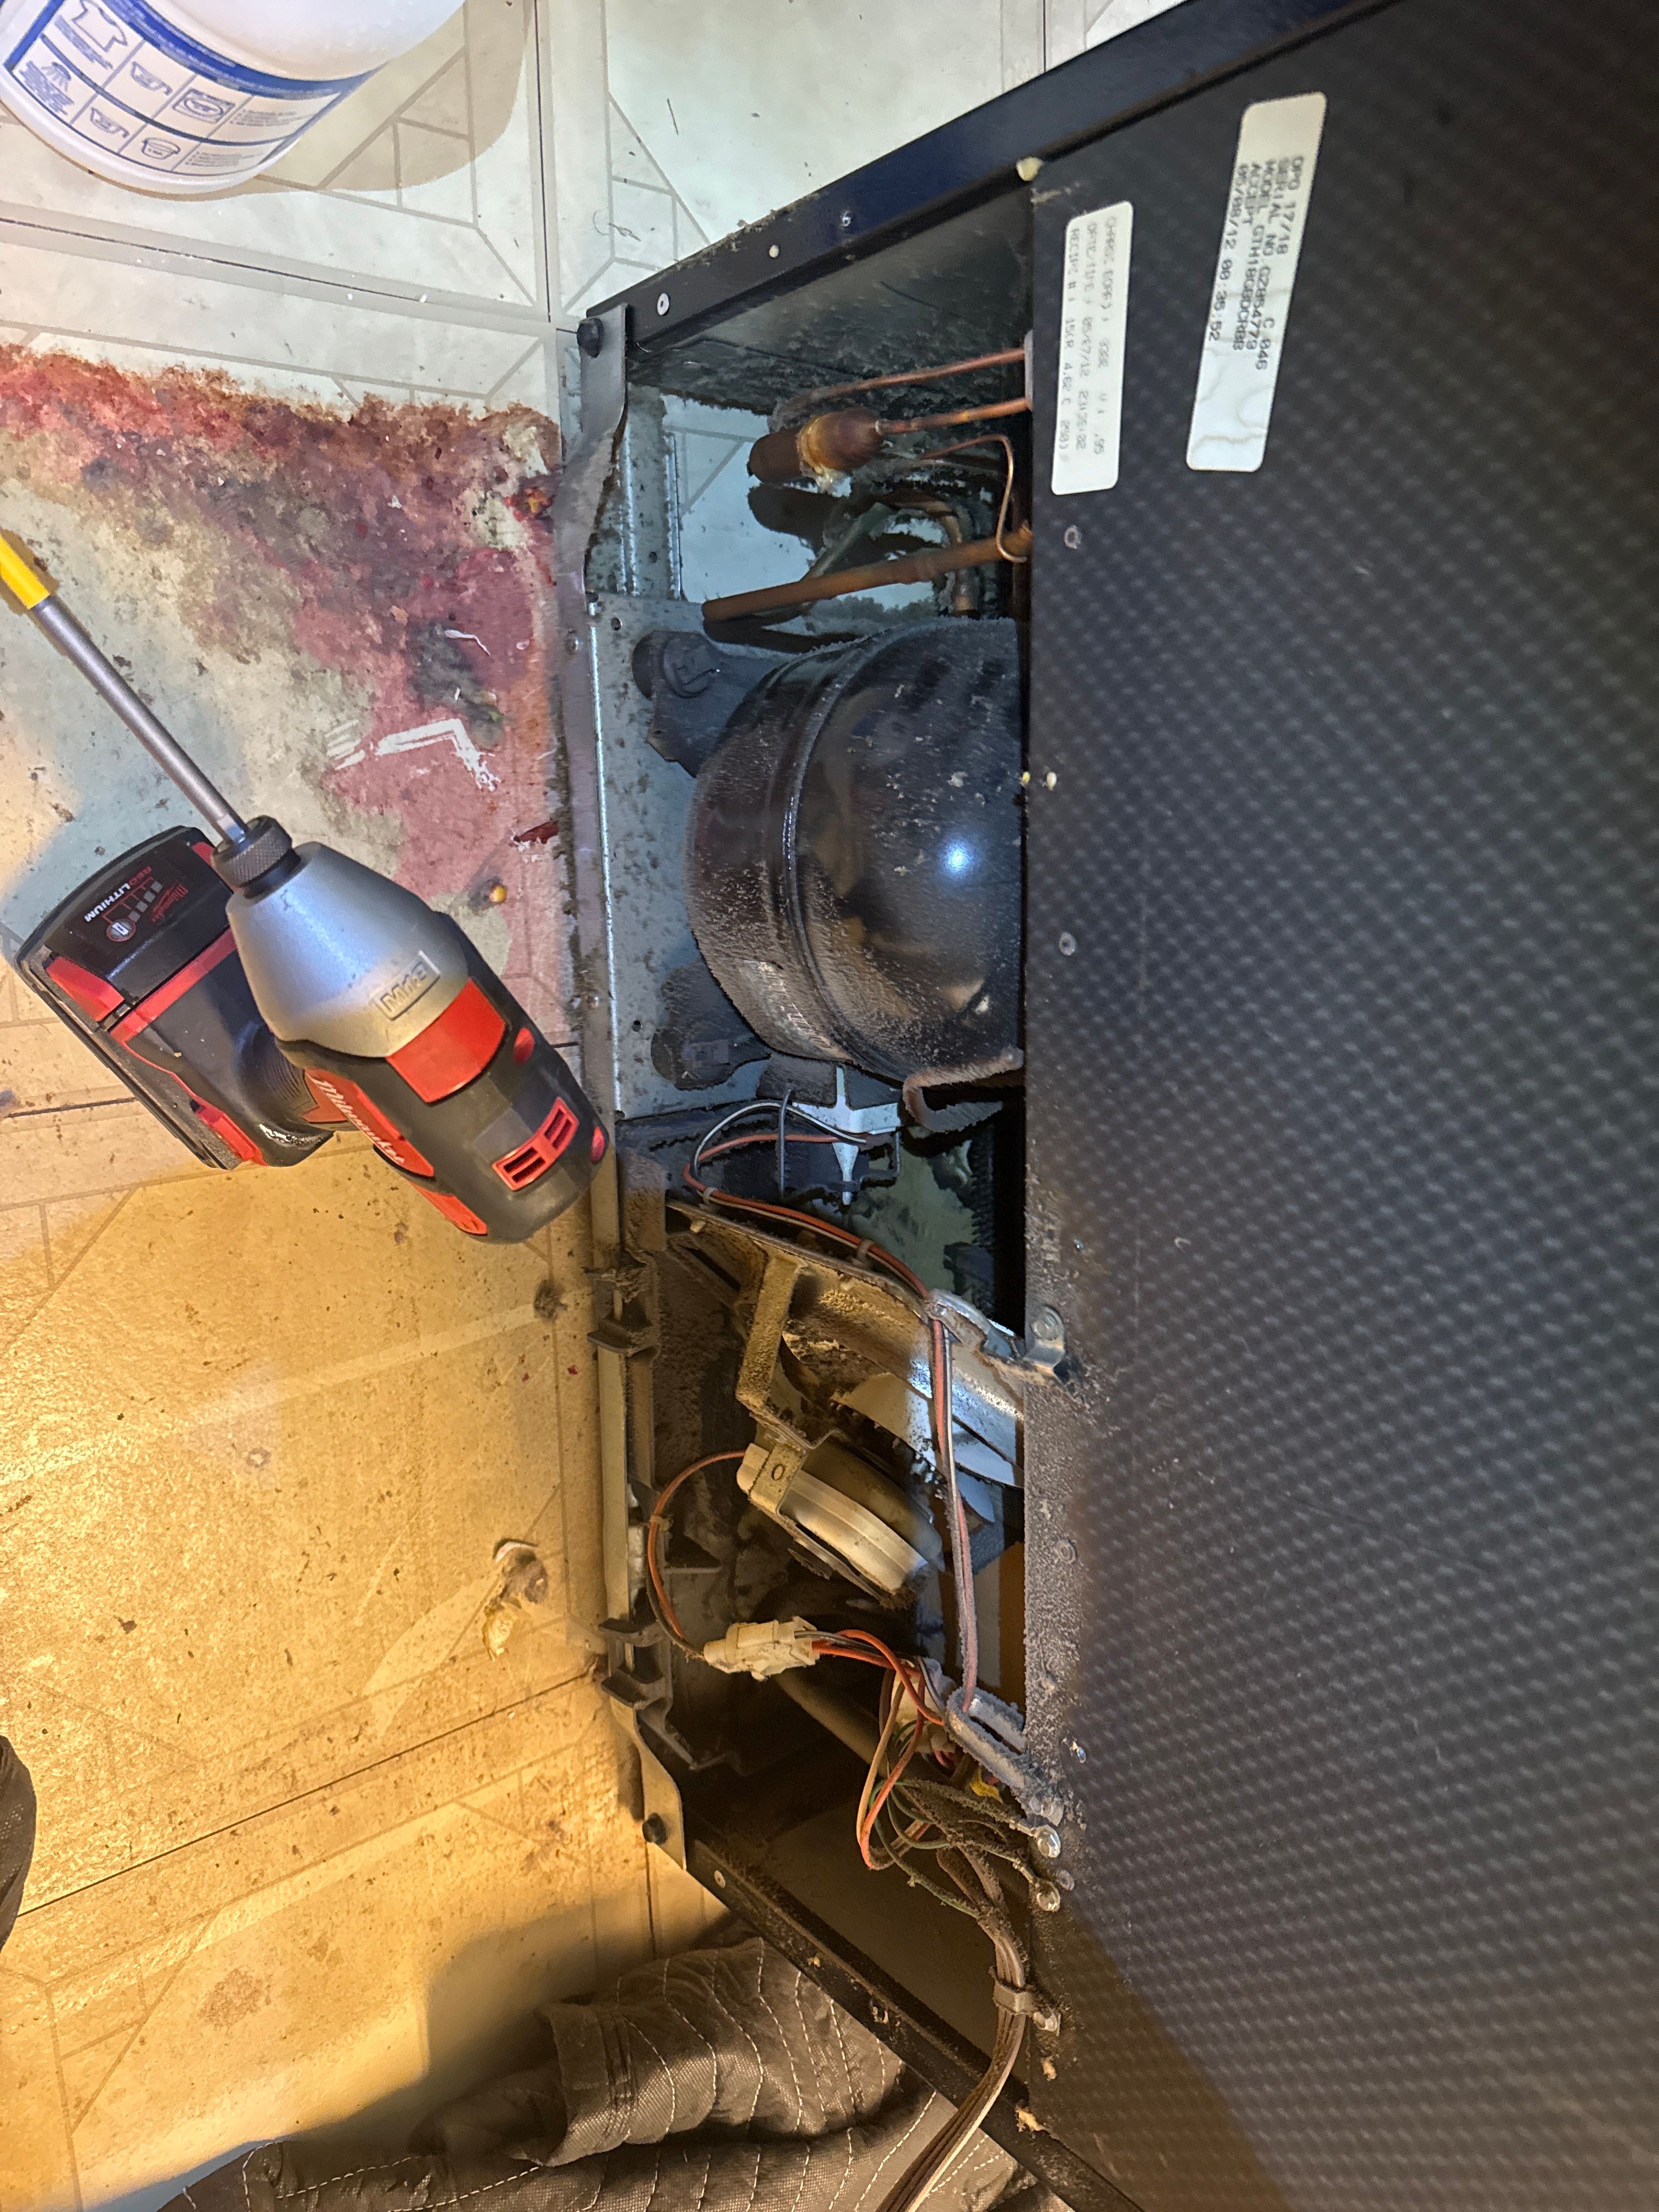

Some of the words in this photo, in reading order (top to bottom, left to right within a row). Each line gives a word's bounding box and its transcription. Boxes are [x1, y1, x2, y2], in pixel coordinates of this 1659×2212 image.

[1242, 162, 1262, 225] ACCEPT
[1256, 159, 1276, 215] MODEL
[1267, 157, 1290, 224] SERIAL
[308, 1075, 405, 1164] Milwaukee
